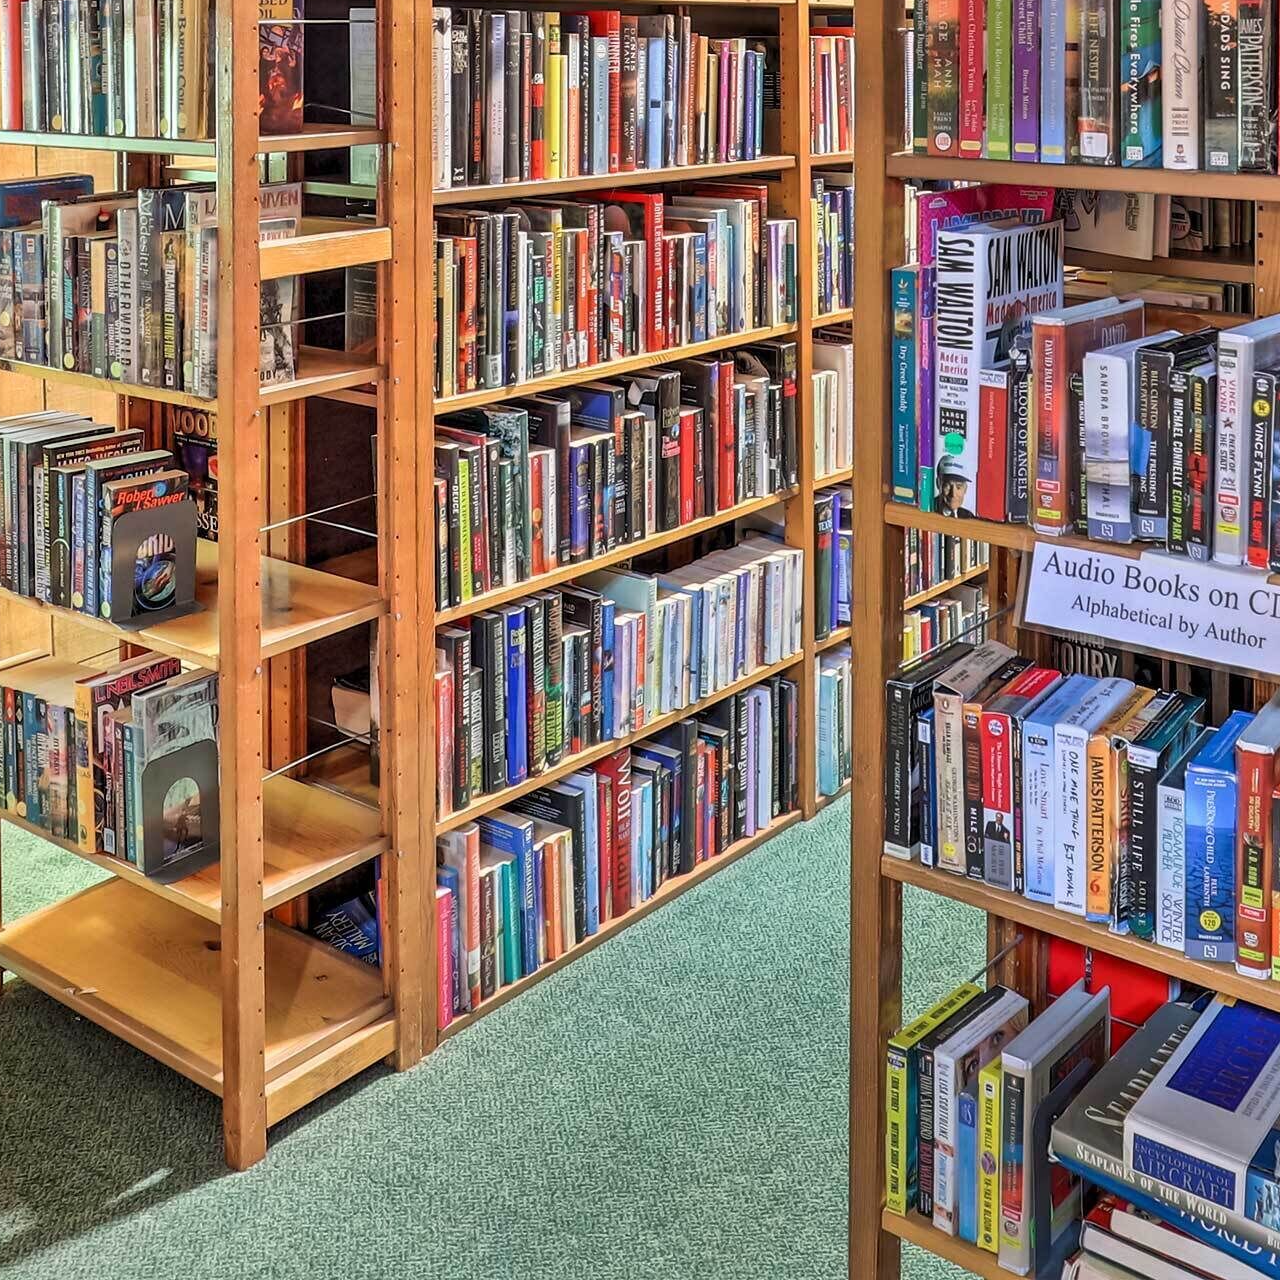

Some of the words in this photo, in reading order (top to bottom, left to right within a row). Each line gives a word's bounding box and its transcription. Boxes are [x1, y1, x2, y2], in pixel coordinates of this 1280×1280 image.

[1129, 17, 1141, 47] Fires
[1129, 51, 1141, 134] Everywhere
[654, 202, 663, 225] John
[937, 237, 974, 273] SAM
[121, 261, 131, 368] OTHERWORLD
[654, 291, 663, 330] HUNTER
[936, 282, 973, 351] WALTON
[1100, 365, 1108, 411] SANDRA
[1254, 422, 1264, 457] VINCE
[1253, 462, 1263, 498] FLYNN
[1042, 550, 1115, 585] Audio
[1122, 565, 1200, 603] Books
[1209, 591, 1239, 610] on
[1071, 594, 1172, 630] Alphabetical
[1178, 616, 1200, 639] by
[1204, 622, 1267, 650] Author
[105, 677, 136, 700] NEIL
[137, 658, 181, 687] SMITH
[1090, 756, 1104, 794] JAMES
[1131, 781, 1144, 831] STILL
[1090, 797, 1104, 872] PATTERSON
[1131, 836, 1143, 879] LIFE
[1075, 1144, 1136, 1184] SEAPLANES
[1140, 1175, 1154, 1191] OF
[1158, 1182, 1180, 1205] THE
[1186, 1196, 1227, 1225] WORLD
[1135, 1142, 1212, 1184] ENCYCLOPEDIA
[1216, 1175, 1230, 1187] OF
[1136, 1154, 1233, 1208] AIRCRAFT
